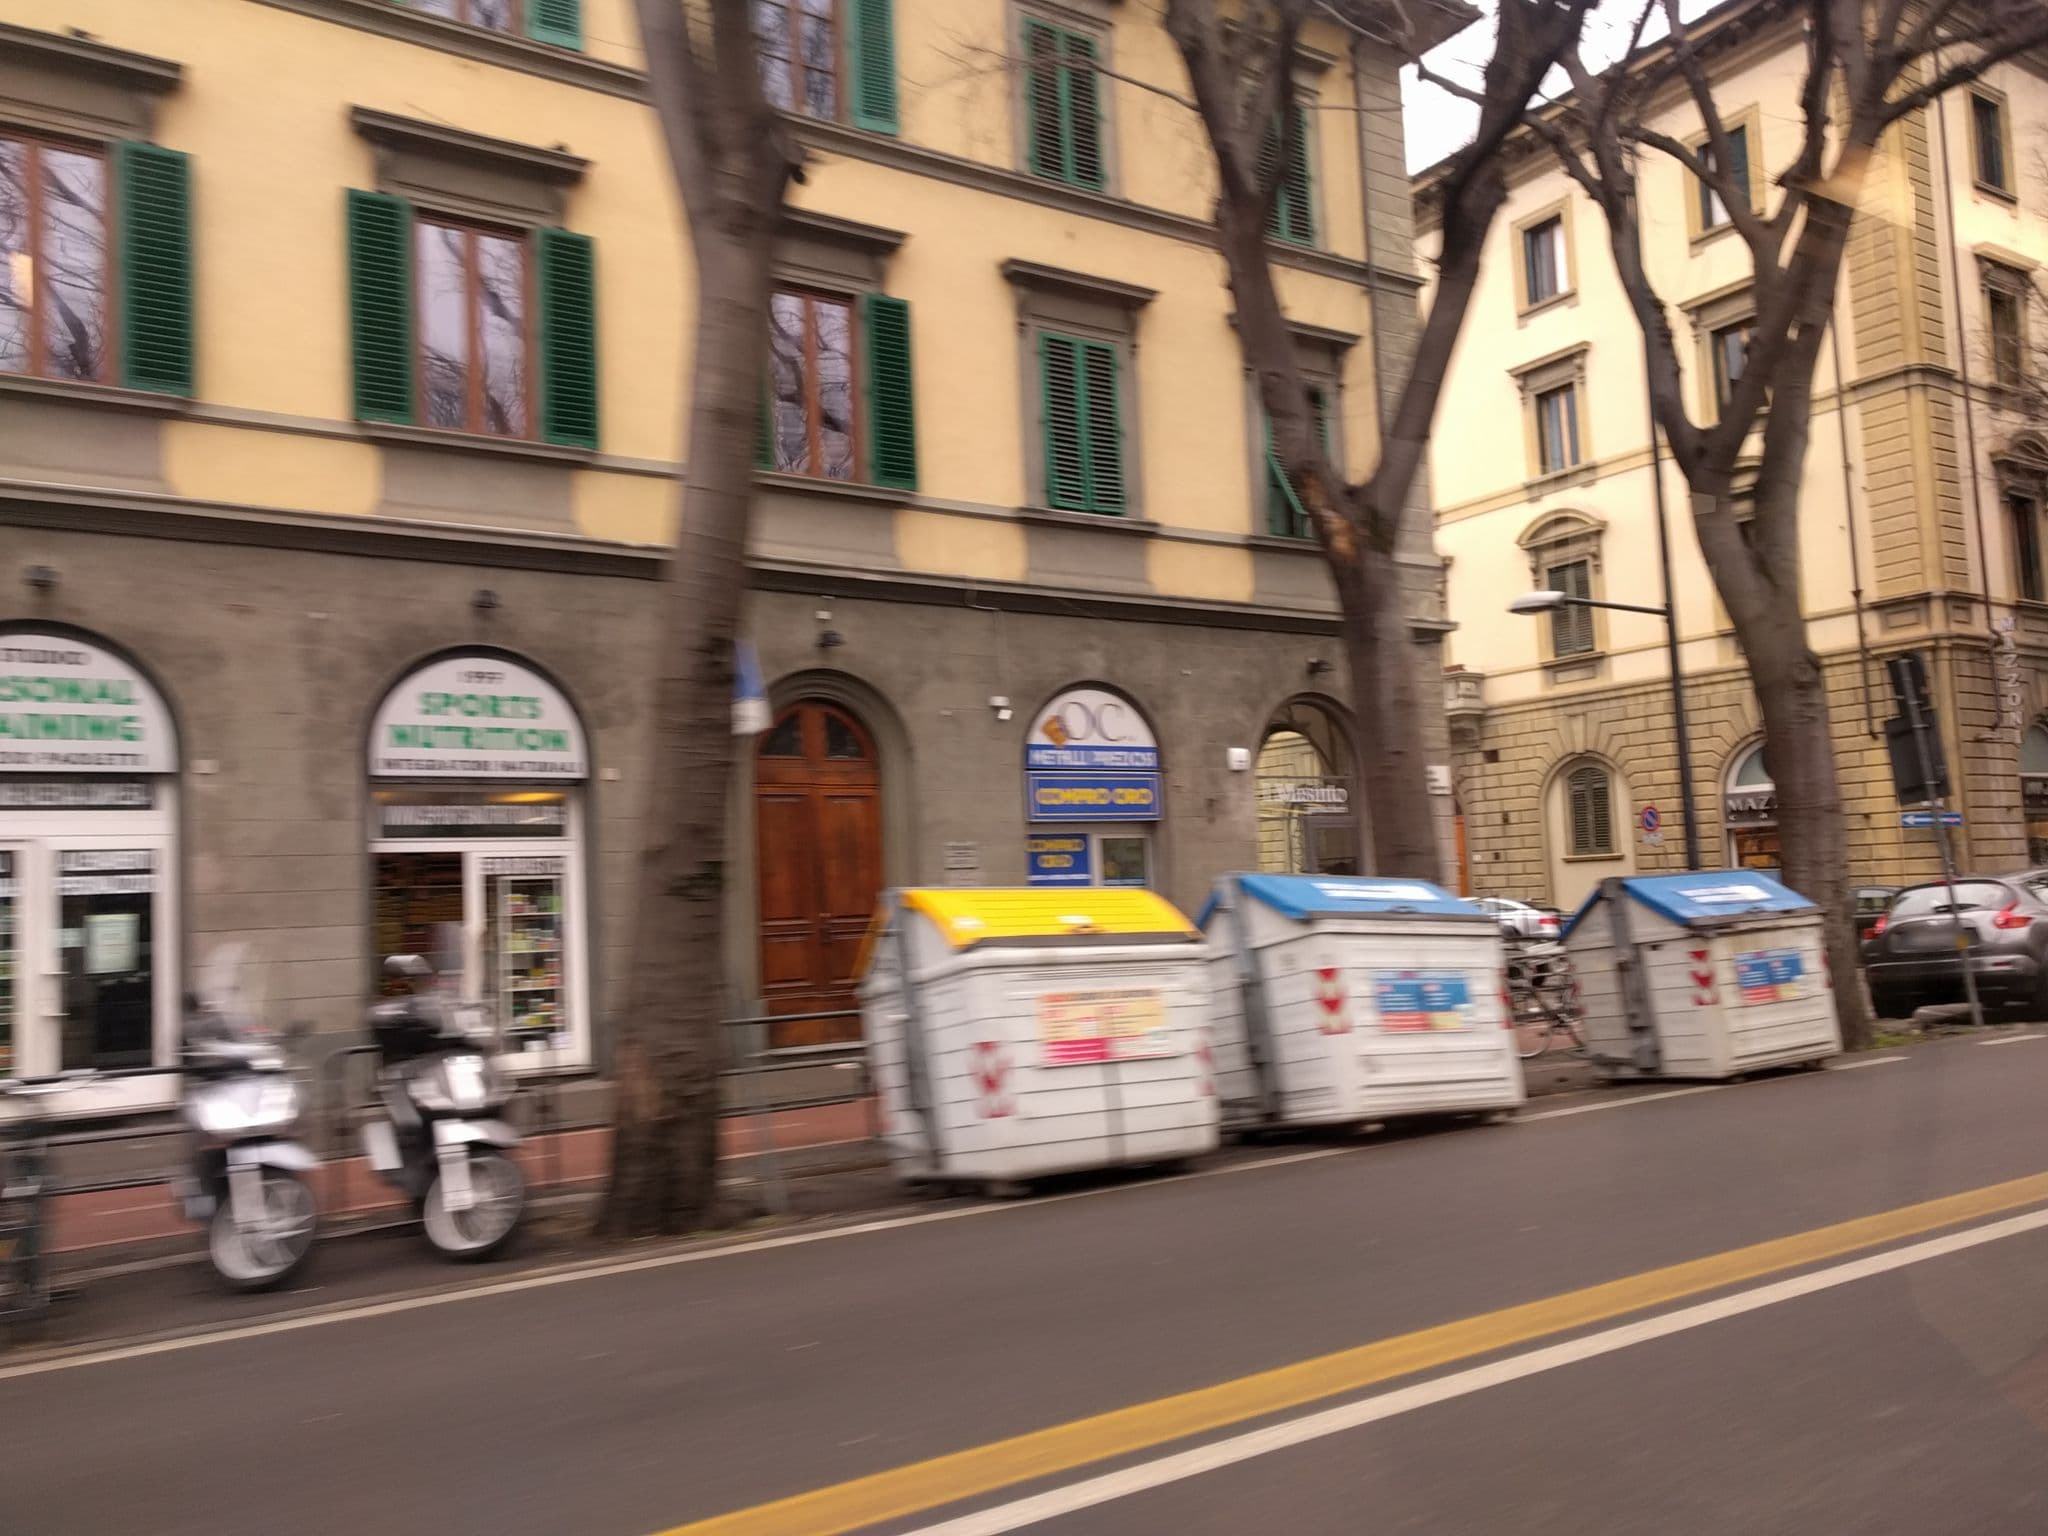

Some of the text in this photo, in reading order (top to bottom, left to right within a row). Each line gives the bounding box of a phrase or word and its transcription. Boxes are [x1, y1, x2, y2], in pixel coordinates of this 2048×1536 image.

[420, 692, 543, 720] SPORTS
[388, 725, 572, 752] NUTRITION
[1037, 788, 1152, 805] COMPRO ORO
[1727, 796, 1778, 811] MAZ
